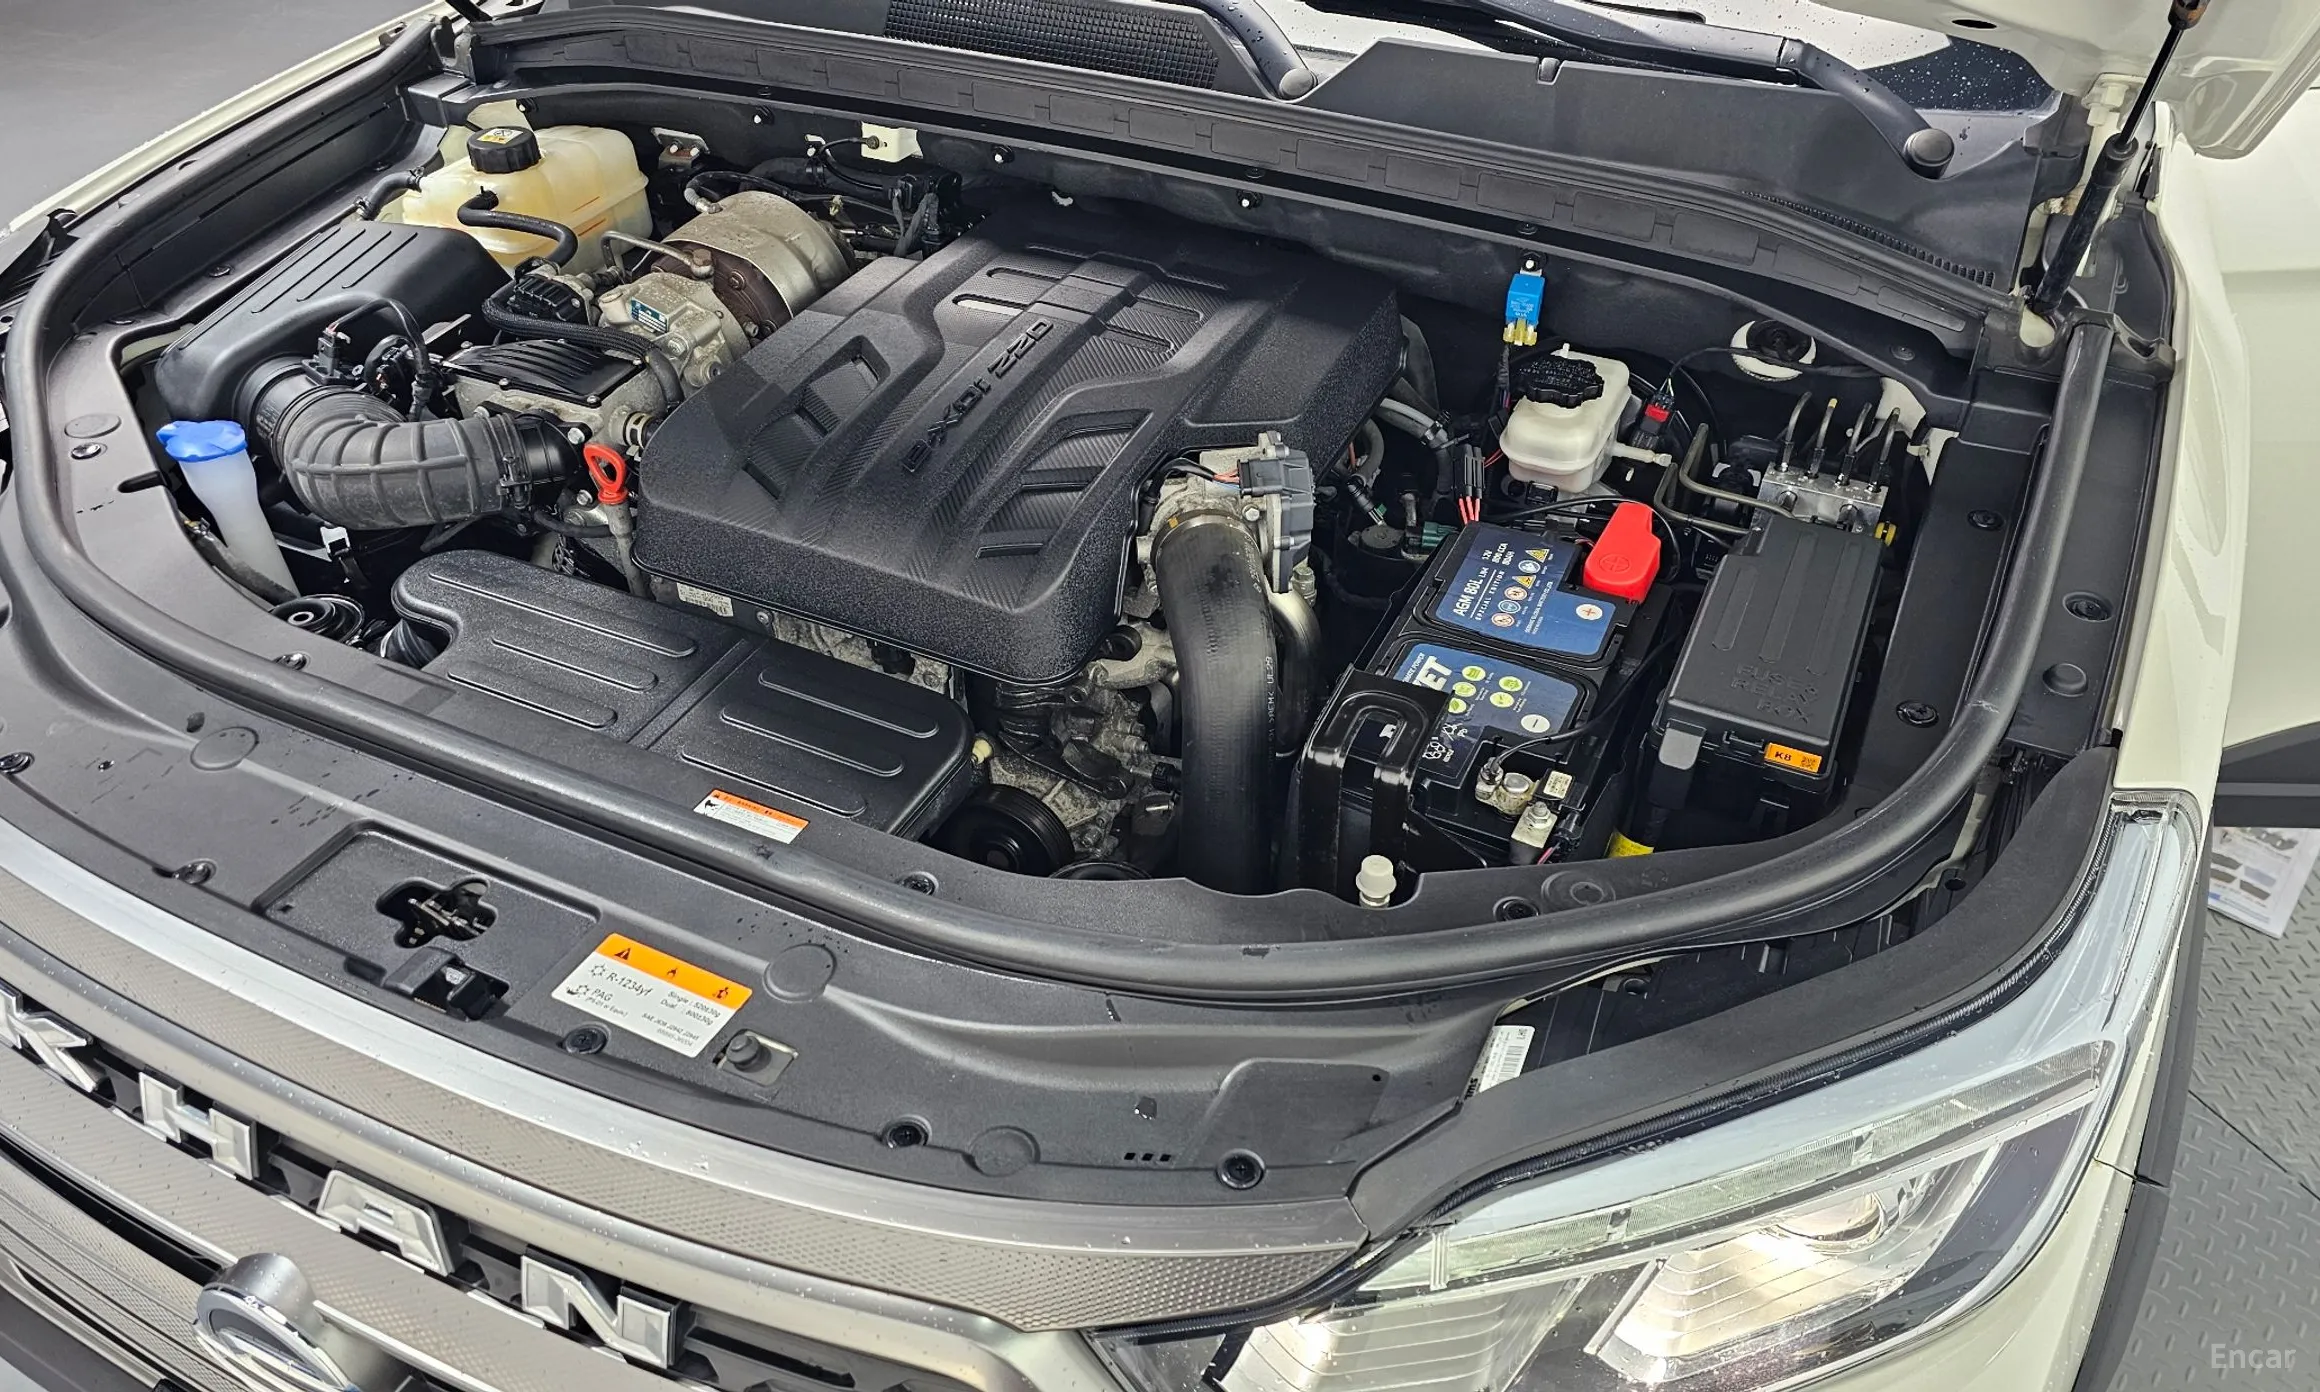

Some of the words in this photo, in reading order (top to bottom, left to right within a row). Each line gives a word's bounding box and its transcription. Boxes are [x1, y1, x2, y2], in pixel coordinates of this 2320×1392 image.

[988, 318, 1053, 379] 220
[1453, 592, 1471, 617] AGM
[1464, 577, 1484, 597] 80L
[1775, 751, 1792, 761] K8
[591, 988, 613, 1001] PAG
[606, 972, 653, 997] R-1234yf
